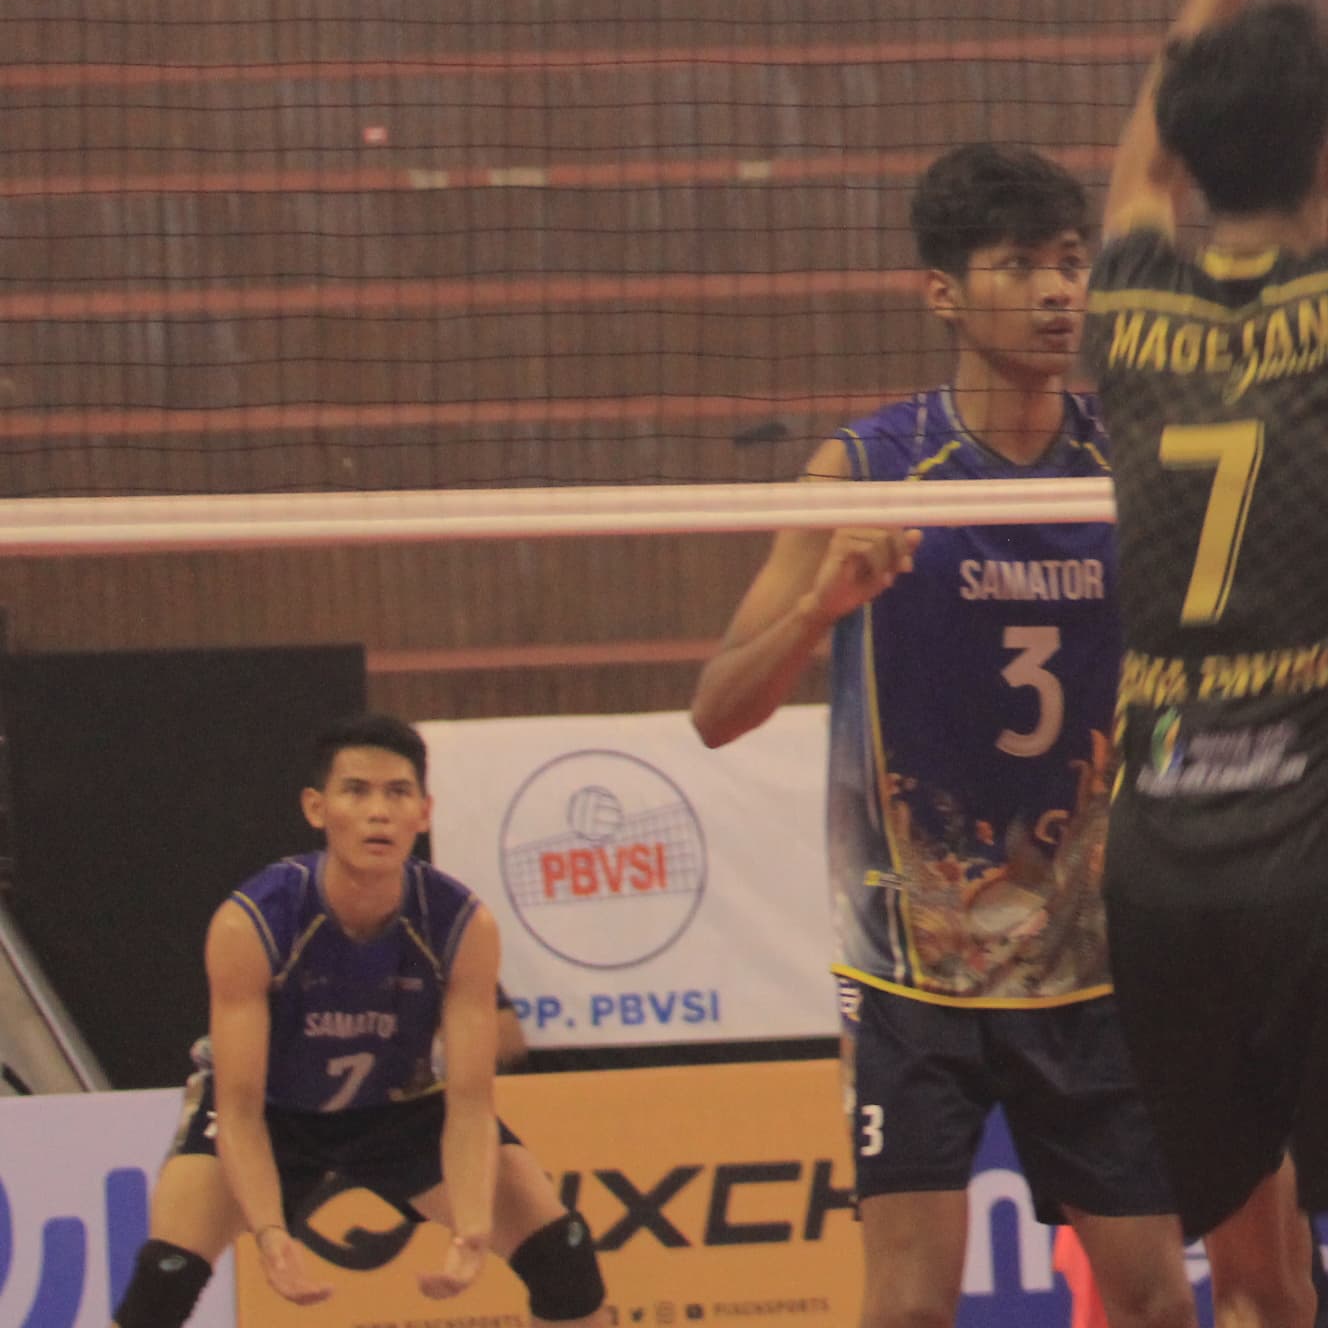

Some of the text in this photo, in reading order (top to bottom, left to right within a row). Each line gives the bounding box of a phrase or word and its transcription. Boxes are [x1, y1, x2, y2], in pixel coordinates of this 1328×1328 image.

[1157, 419, 1265, 627] 7
[959, 558, 1105, 601] SAMATOR
[995, 625, 1065, 758] 3
[540, 841, 668, 902] PBVSI
[303, 1010, 399, 1040] SAMATO
[590, 989, 720, 1027] PBVSI
[320, 1051, 376, 1113] 7
[859, 1104, 885, 1157] 3
